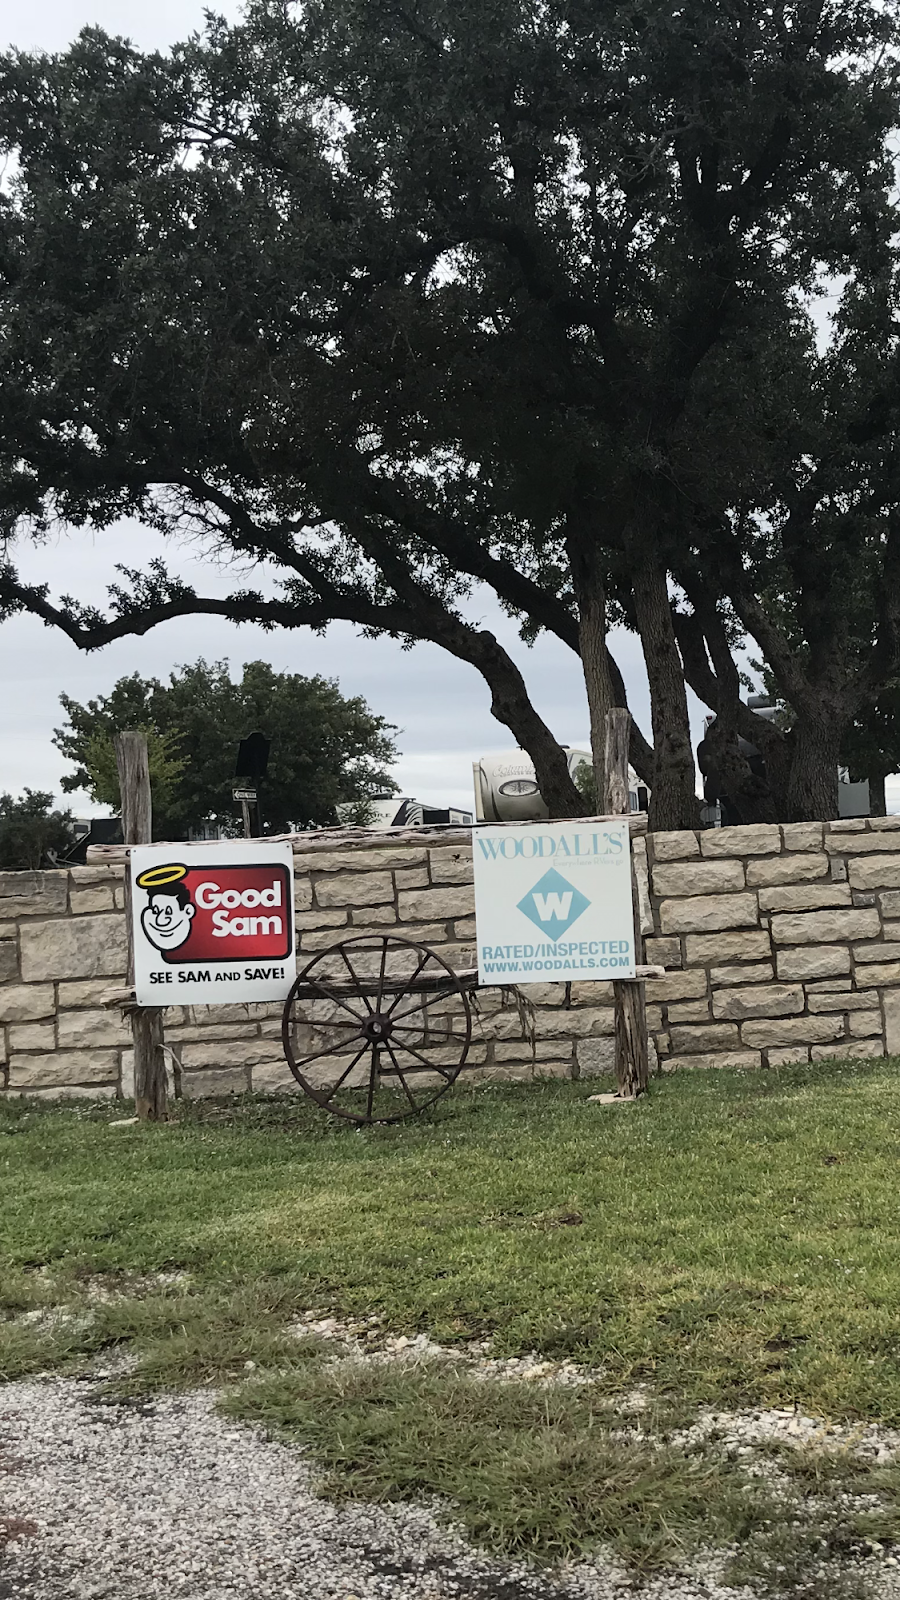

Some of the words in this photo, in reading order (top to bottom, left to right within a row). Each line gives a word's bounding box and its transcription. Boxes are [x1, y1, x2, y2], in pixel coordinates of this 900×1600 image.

[476, 832, 623, 860] WOODALL'S
[195, 880, 282, 909] Good
[531, 891, 573, 921] W
[211, 910, 282, 937] Sam
[482, 940, 630, 960] RATED/INSPECTED
[150, 972, 173, 984] SEE
[178, 970, 211, 983] SAM
[215, 971, 241, 982] AND
[244, 967, 285, 980] SAVE!
[483, 956, 630, 973] WWW.WOODALLS.COM
